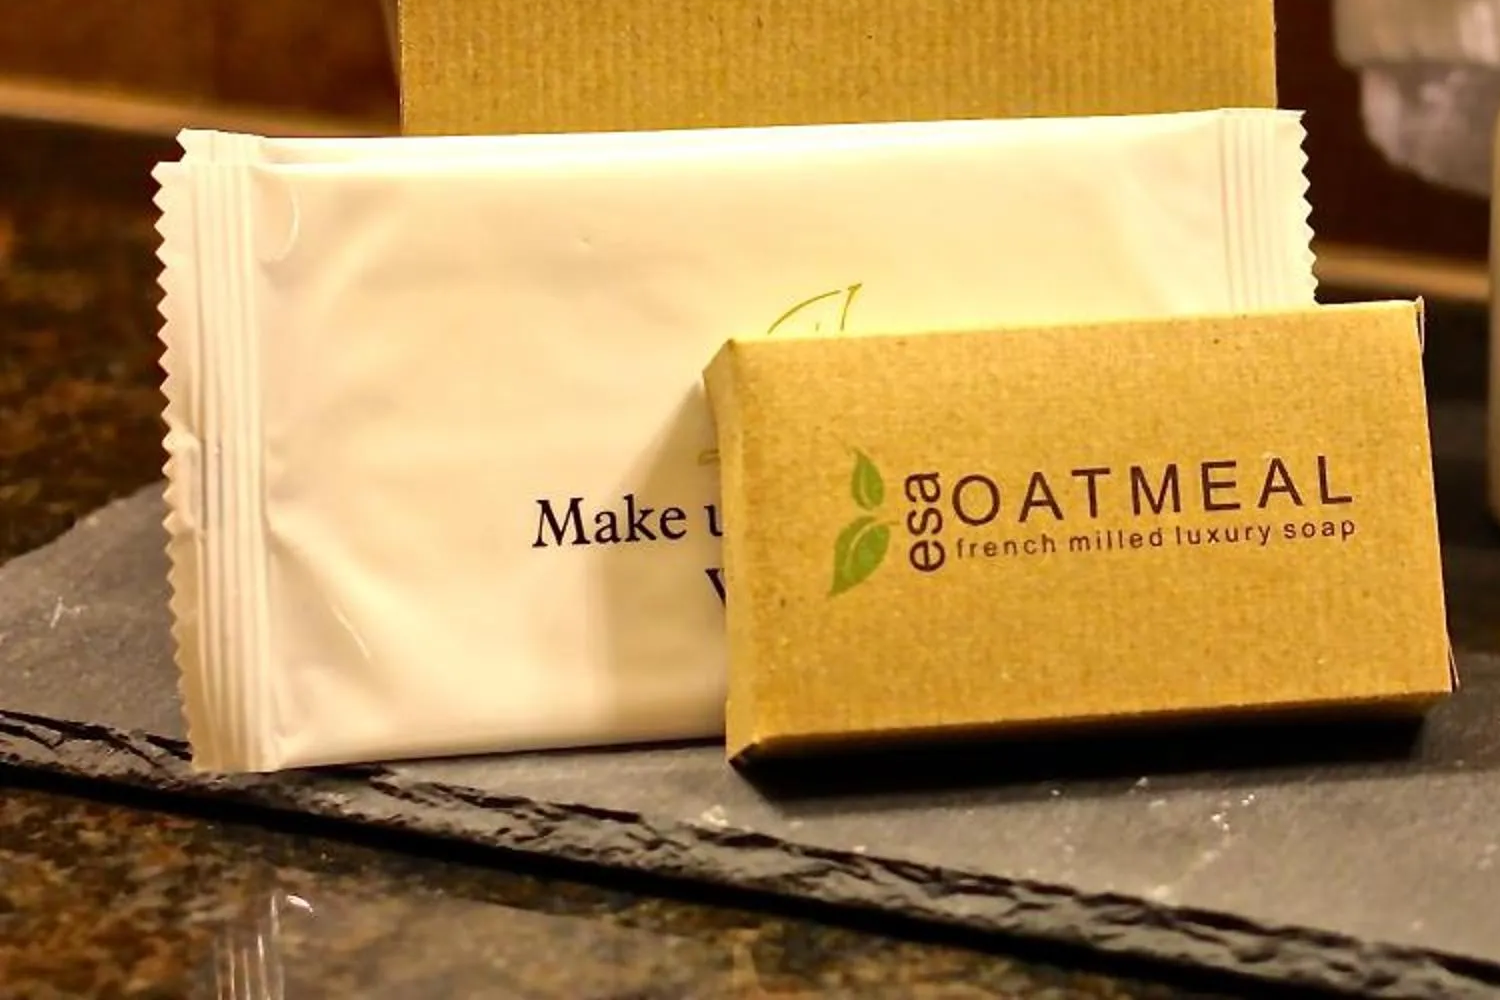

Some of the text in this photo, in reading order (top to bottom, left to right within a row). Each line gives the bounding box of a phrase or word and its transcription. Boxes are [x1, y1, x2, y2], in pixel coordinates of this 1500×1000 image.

[532, 493, 687, 548] Make
[905, 471, 946, 573] esa
[951, 455, 1353, 527] OATMEAL
[955, 518, 1355, 559] french milled luxury soap
